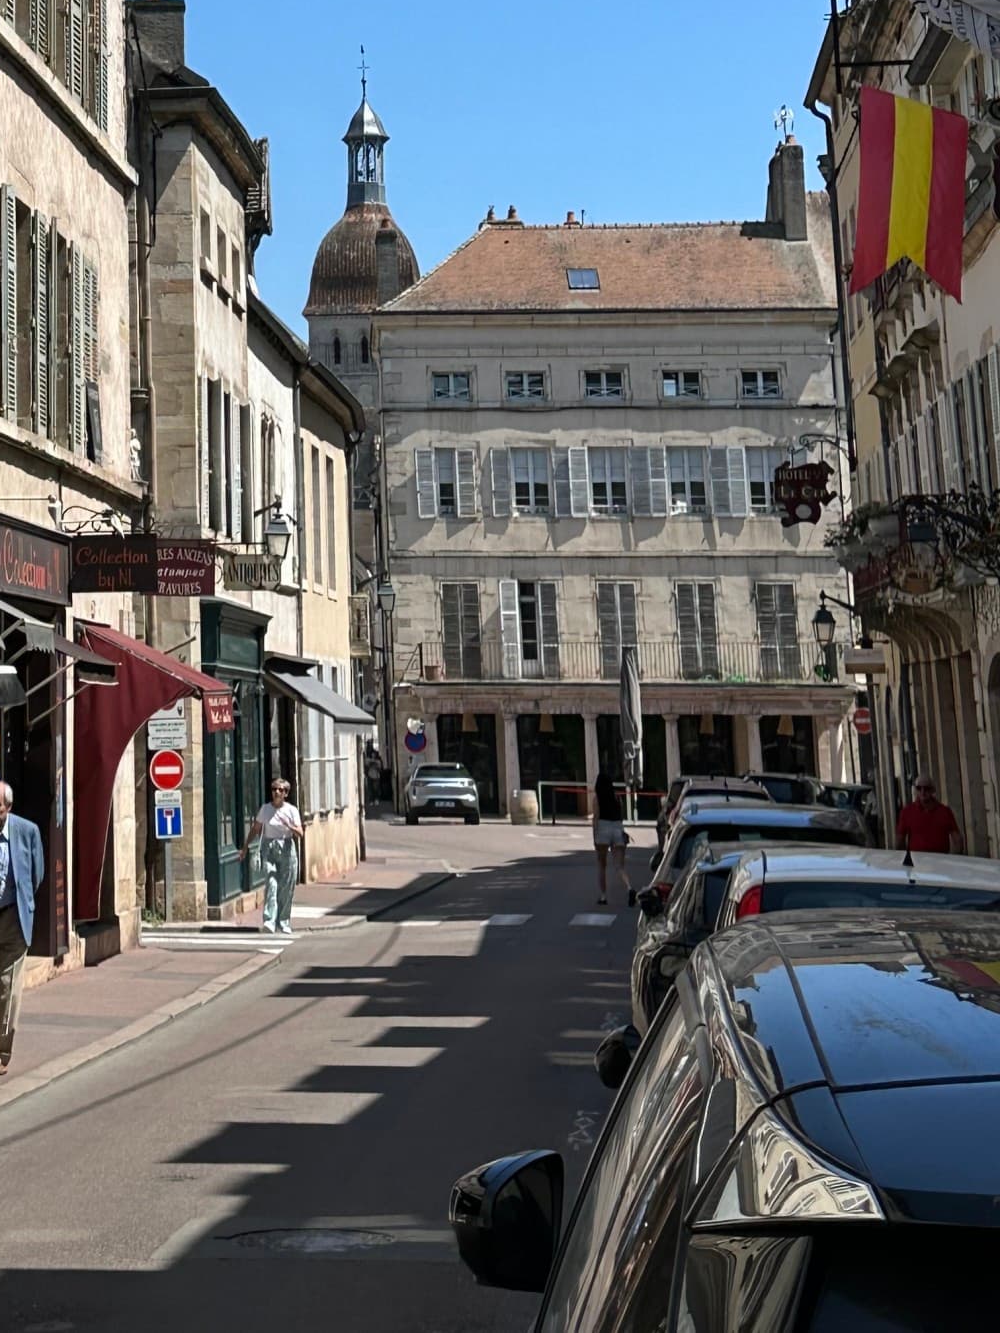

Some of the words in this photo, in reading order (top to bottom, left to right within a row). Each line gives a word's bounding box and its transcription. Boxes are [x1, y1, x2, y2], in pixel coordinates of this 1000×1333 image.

[76, 546, 148, 566] Collection
[156, 547, 175, 562] RES
[98, 569, 115, 592] by
[158, 580, 202, 595] RAVURES
